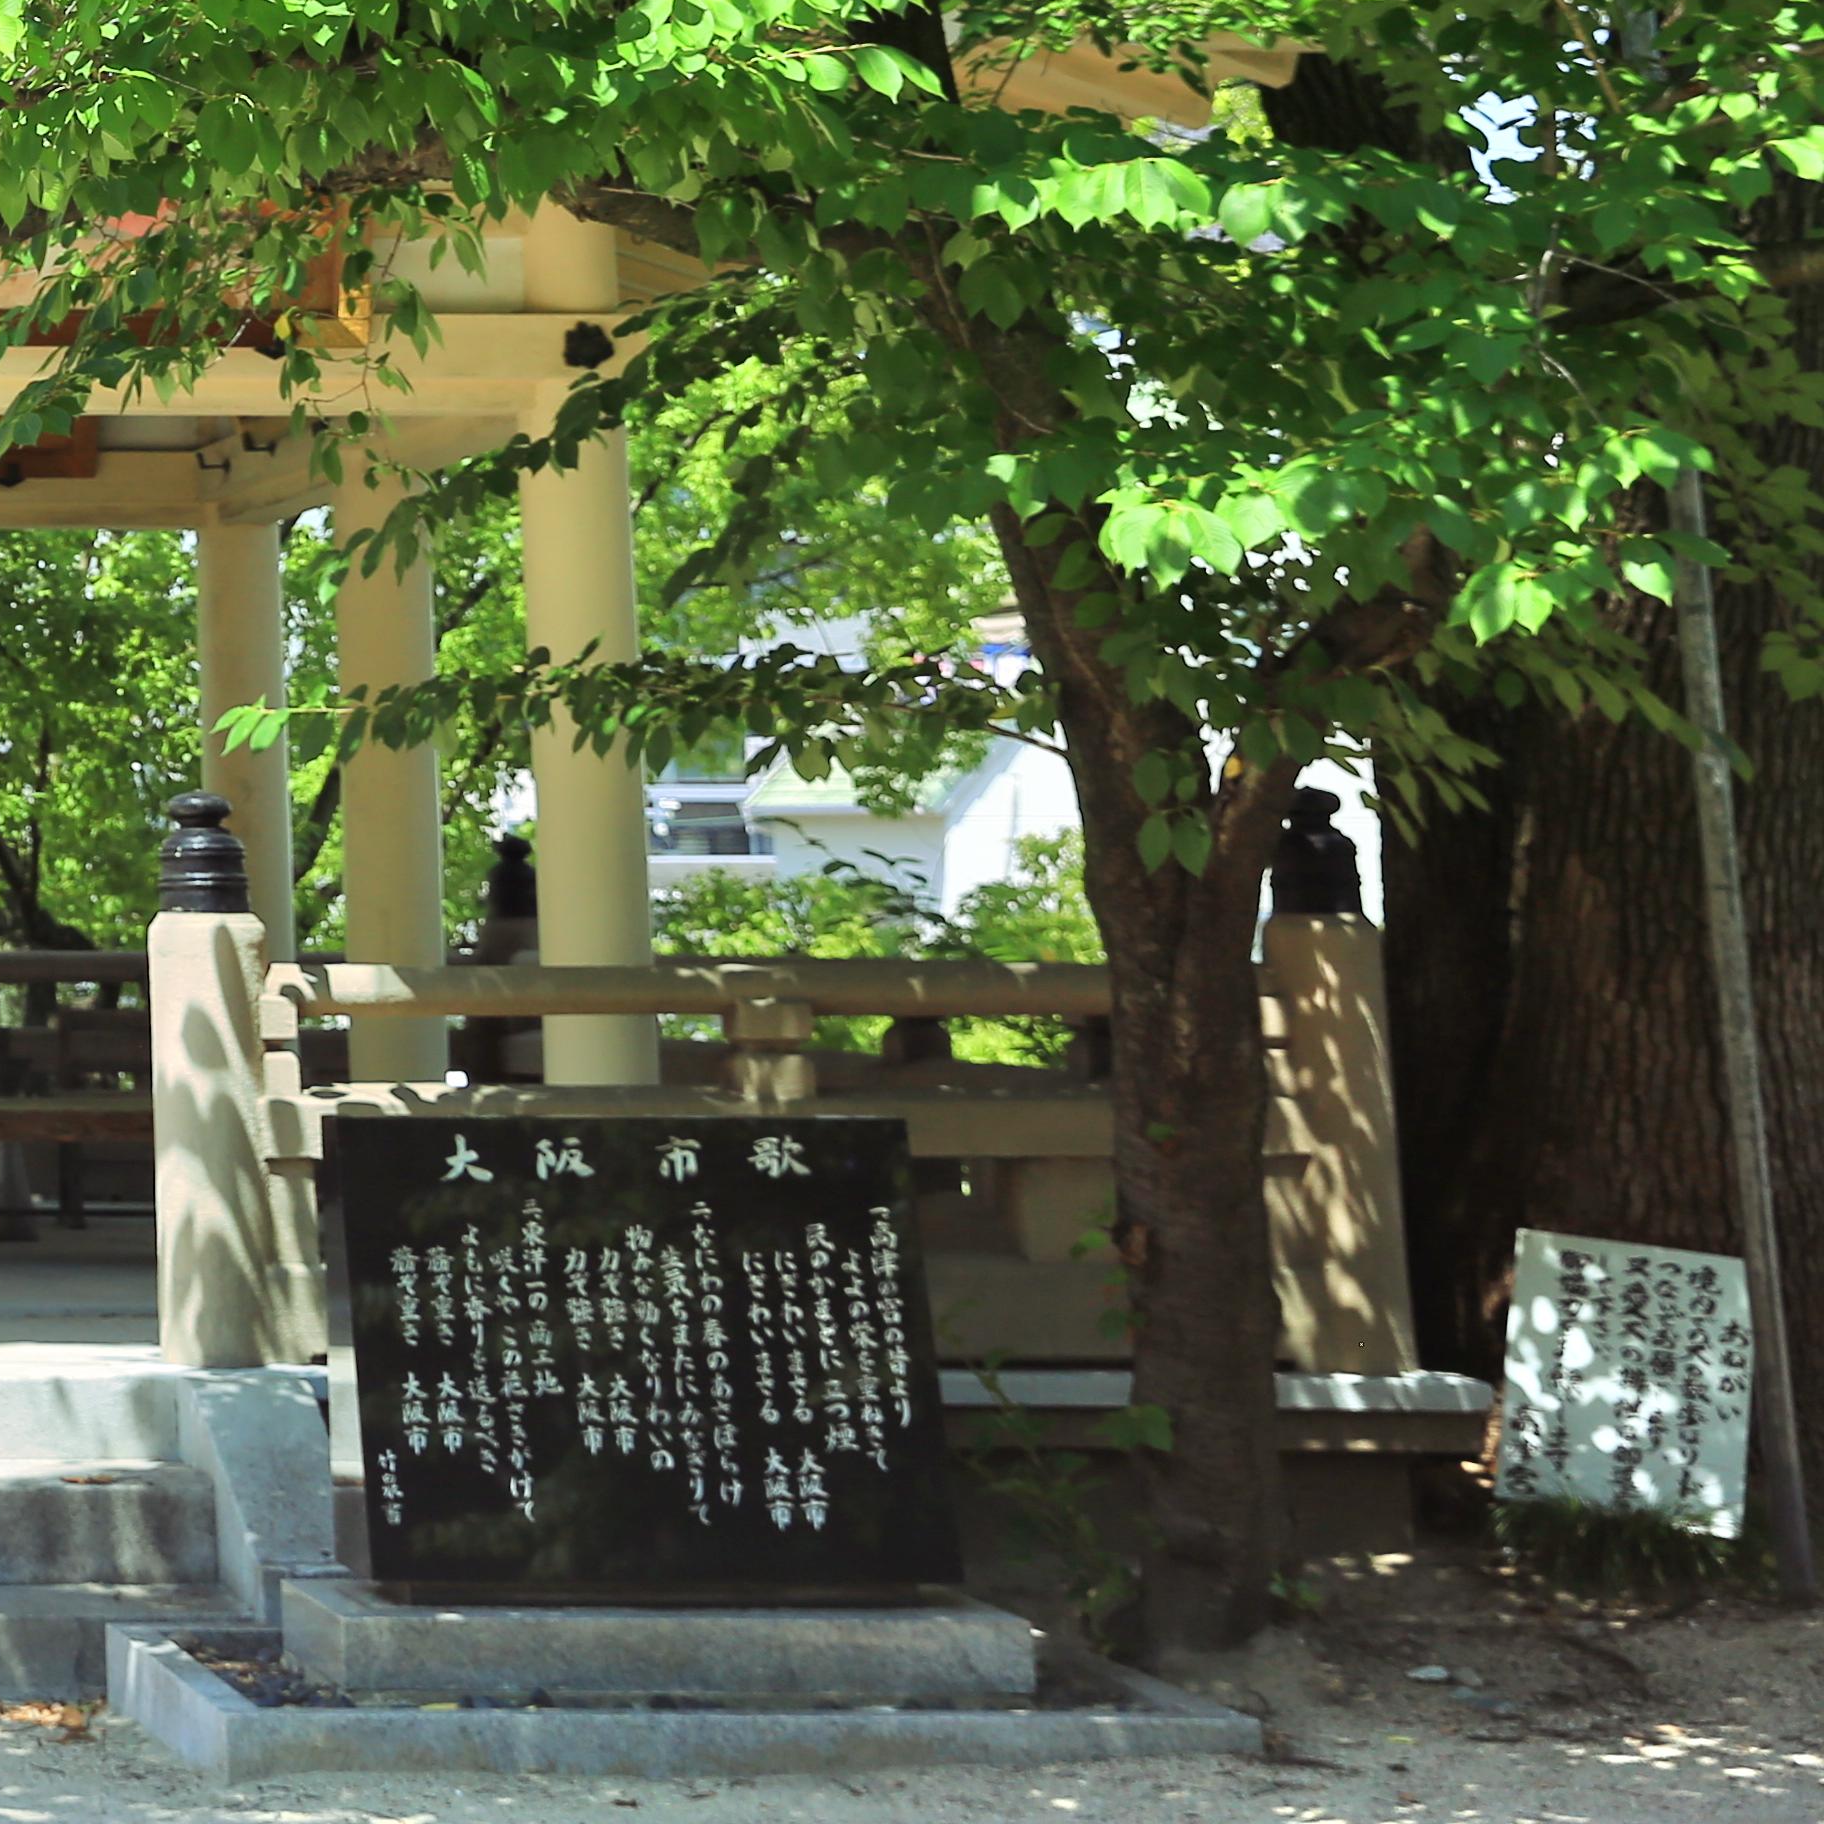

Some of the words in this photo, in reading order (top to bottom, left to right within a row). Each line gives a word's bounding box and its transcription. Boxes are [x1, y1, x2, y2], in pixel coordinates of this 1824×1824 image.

[440, 1133, 813, 1183] 大阪市歌
[460, 1222, 501, 1474] よもに香りを送るべき
[660, 1243, 713, 1528] 生気ちまたにみなぎりて
[742, 1249, 782, 1425] にぎわいまさる
[763, 1446, 796, 1532] 大阪市
[774, 1249, 814, 1425] にぎわいまさる
[797, 1447, 831, 1531] 大阪市
[401, 1370, 433, 1456] 大阪市
[435, 1370, 467, 1455] 大阪市
[576, 1372, 607, 1456] 大阪市
[607, 1372, 640, 1455] 大阪市
